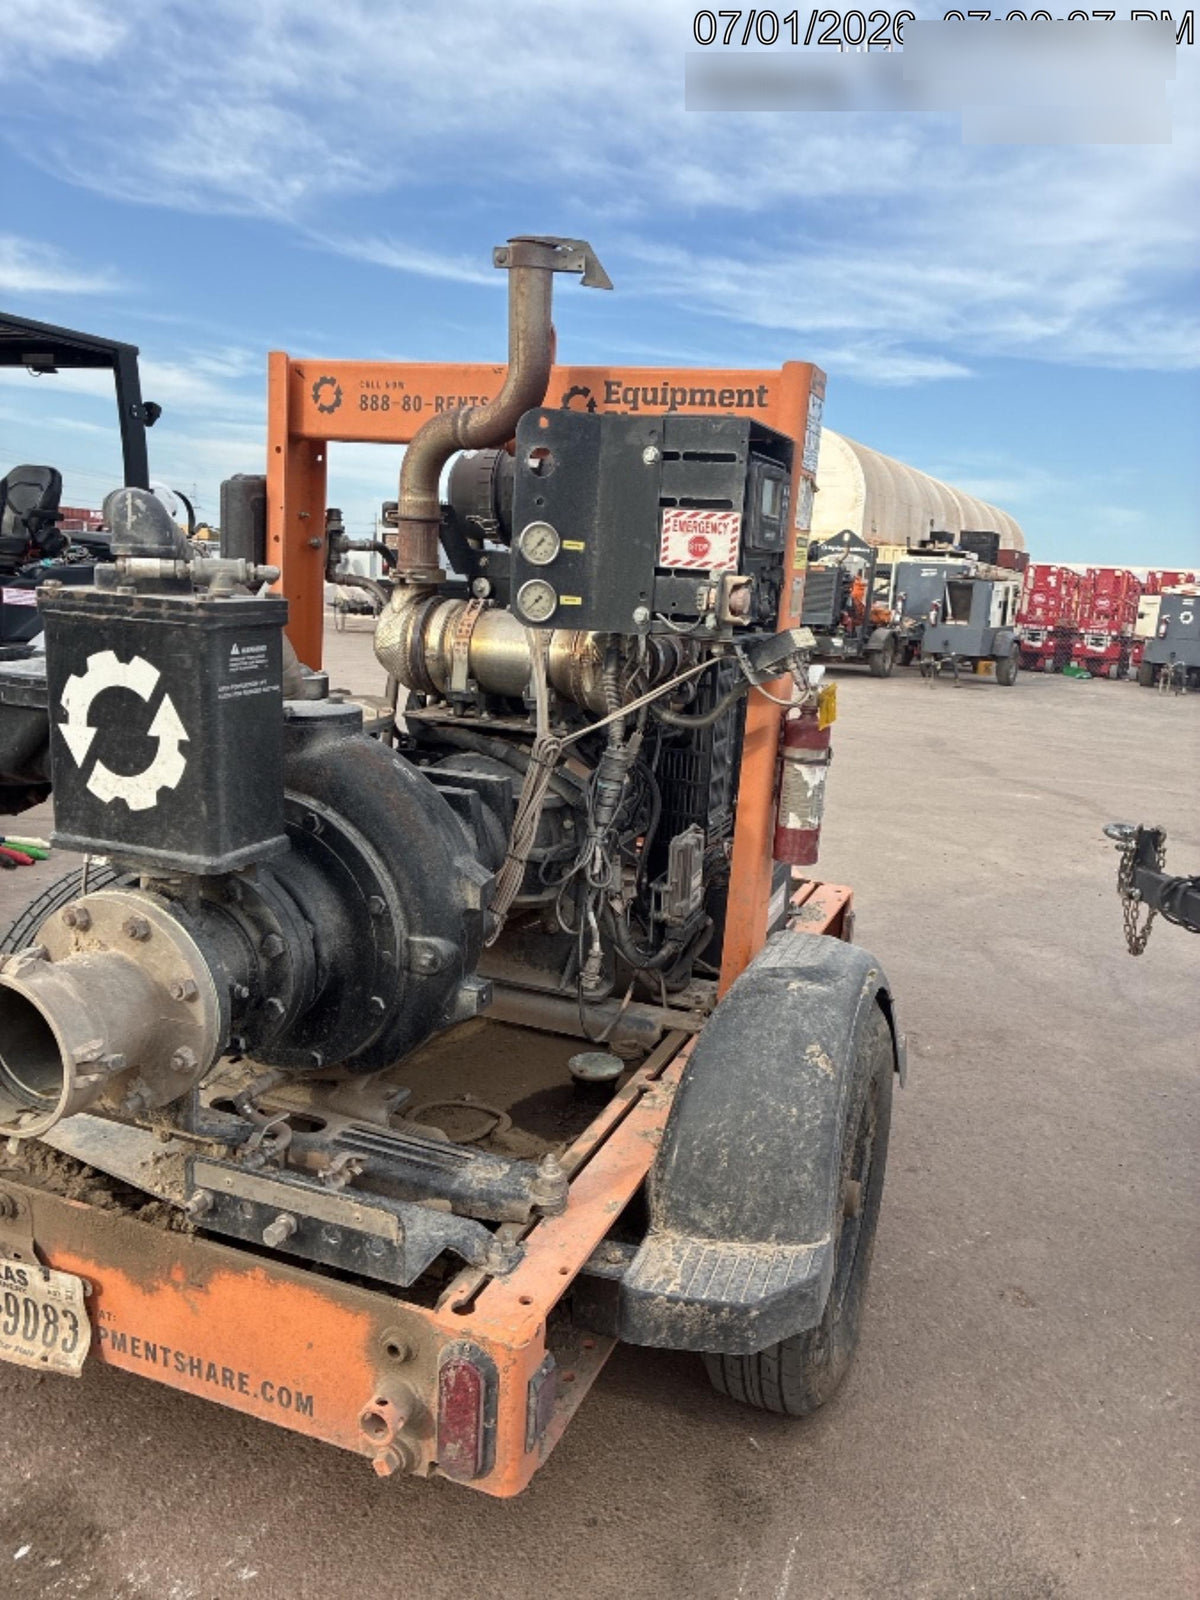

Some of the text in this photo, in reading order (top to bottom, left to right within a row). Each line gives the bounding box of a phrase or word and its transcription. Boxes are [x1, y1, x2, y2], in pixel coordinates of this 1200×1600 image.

[604, 380, 769, 411] Equipment
[672, 518, 730, 535] EMERGENCY
[688, 542, 711, 554] STOP
[0, 1265, 28, 1287] AS
